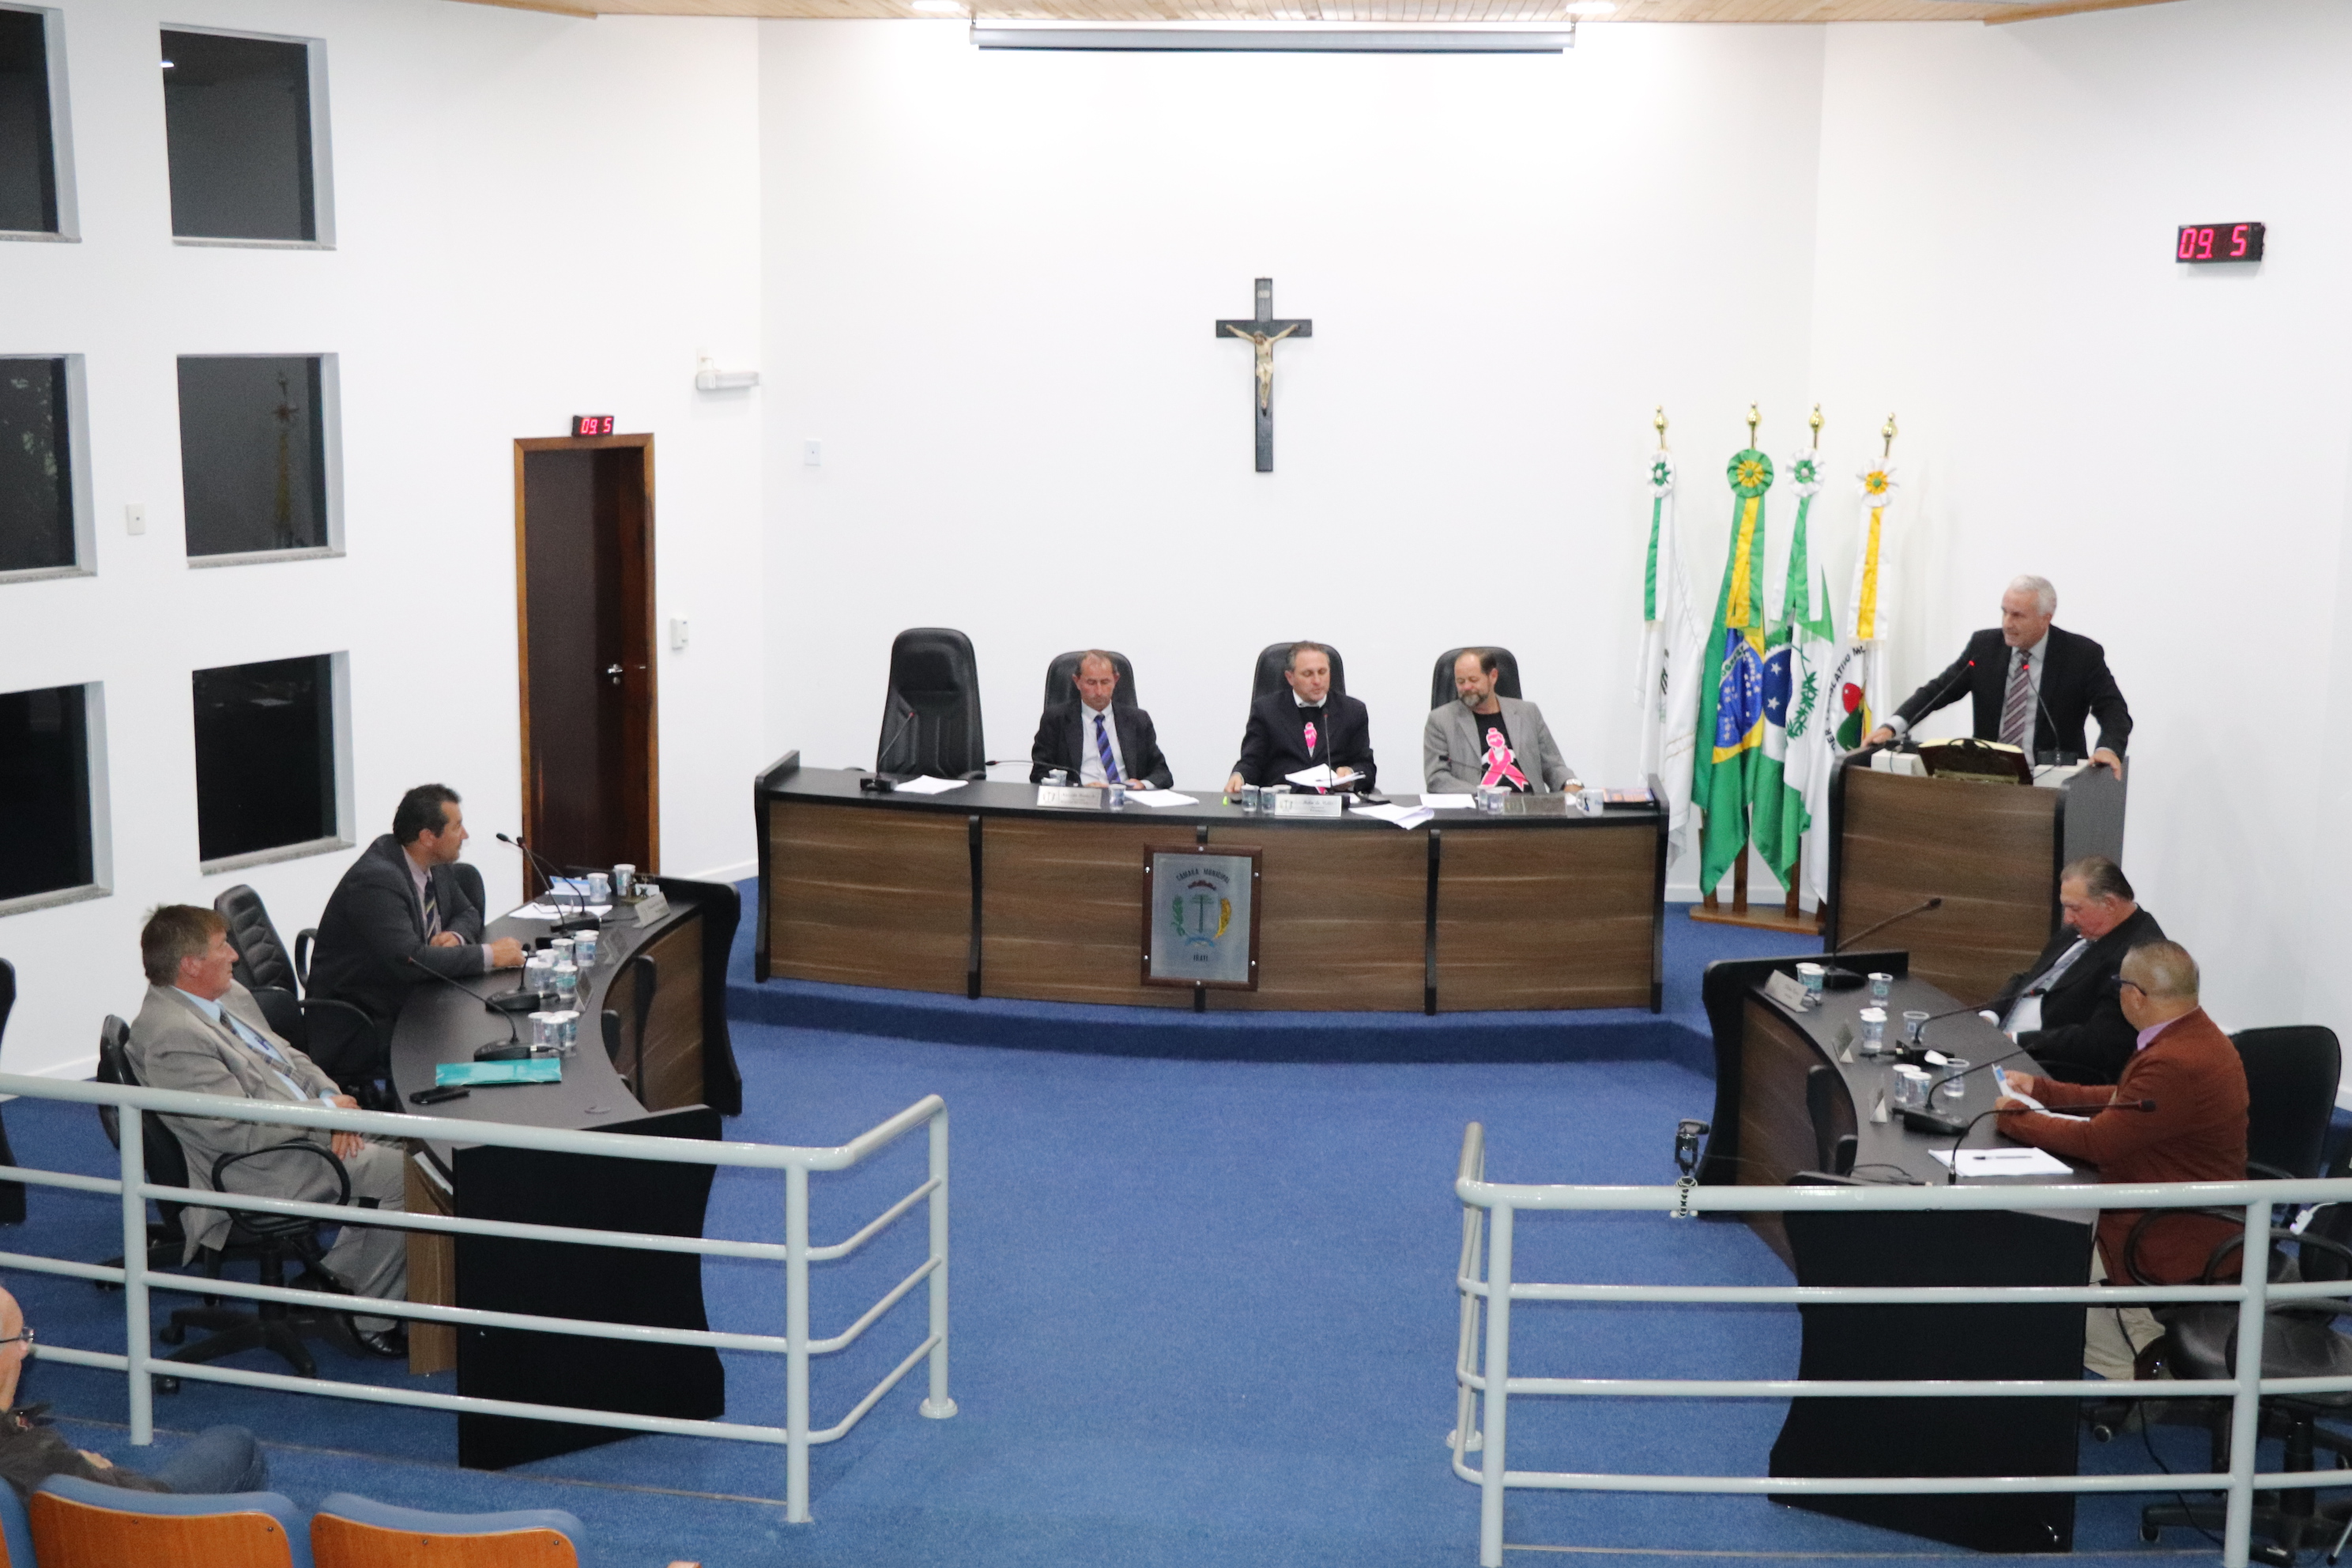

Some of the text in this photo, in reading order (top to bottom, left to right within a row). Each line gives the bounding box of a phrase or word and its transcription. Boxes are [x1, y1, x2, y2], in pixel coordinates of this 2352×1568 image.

[2230, 224, 2248, 257] 5
[602, 416, 613, 433] 5
[1204, 868, 1231, 884] MUNICIPAL
